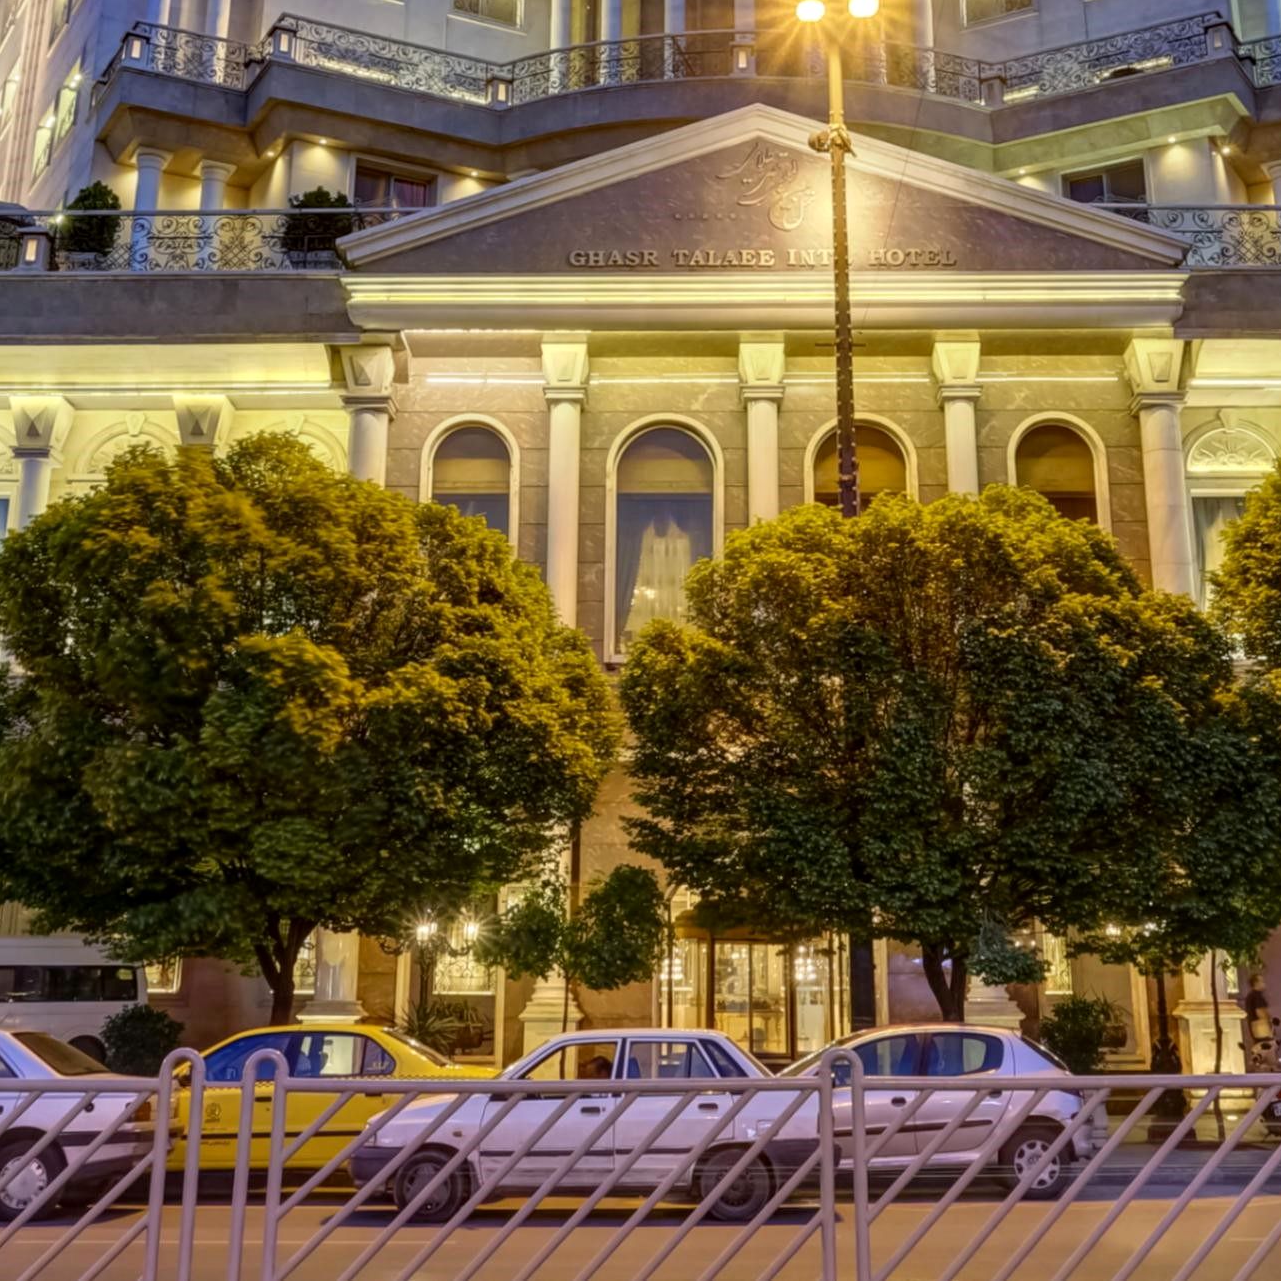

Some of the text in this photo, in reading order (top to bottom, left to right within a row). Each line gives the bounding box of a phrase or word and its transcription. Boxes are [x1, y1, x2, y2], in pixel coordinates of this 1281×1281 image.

[569, 248, 957, 267] GHASR TALAEE INT HOTEL
